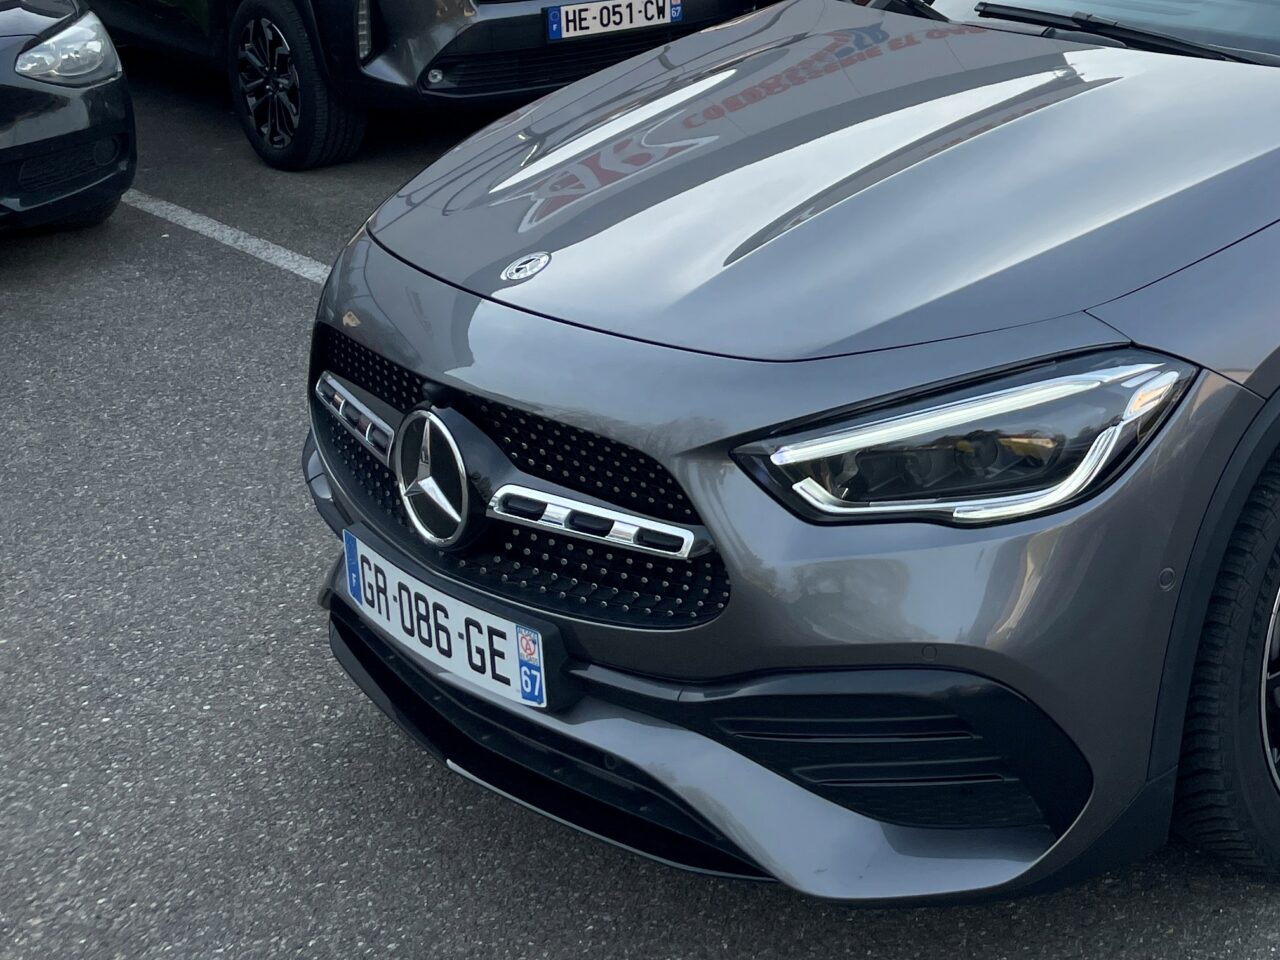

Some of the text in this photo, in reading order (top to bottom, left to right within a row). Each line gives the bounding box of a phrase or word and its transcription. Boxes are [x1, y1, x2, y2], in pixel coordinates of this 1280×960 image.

[671, 6, 681, 17] 67
[360, 553, 512, 687] GR-086-GE
[521, 665, 541, 697] 67
